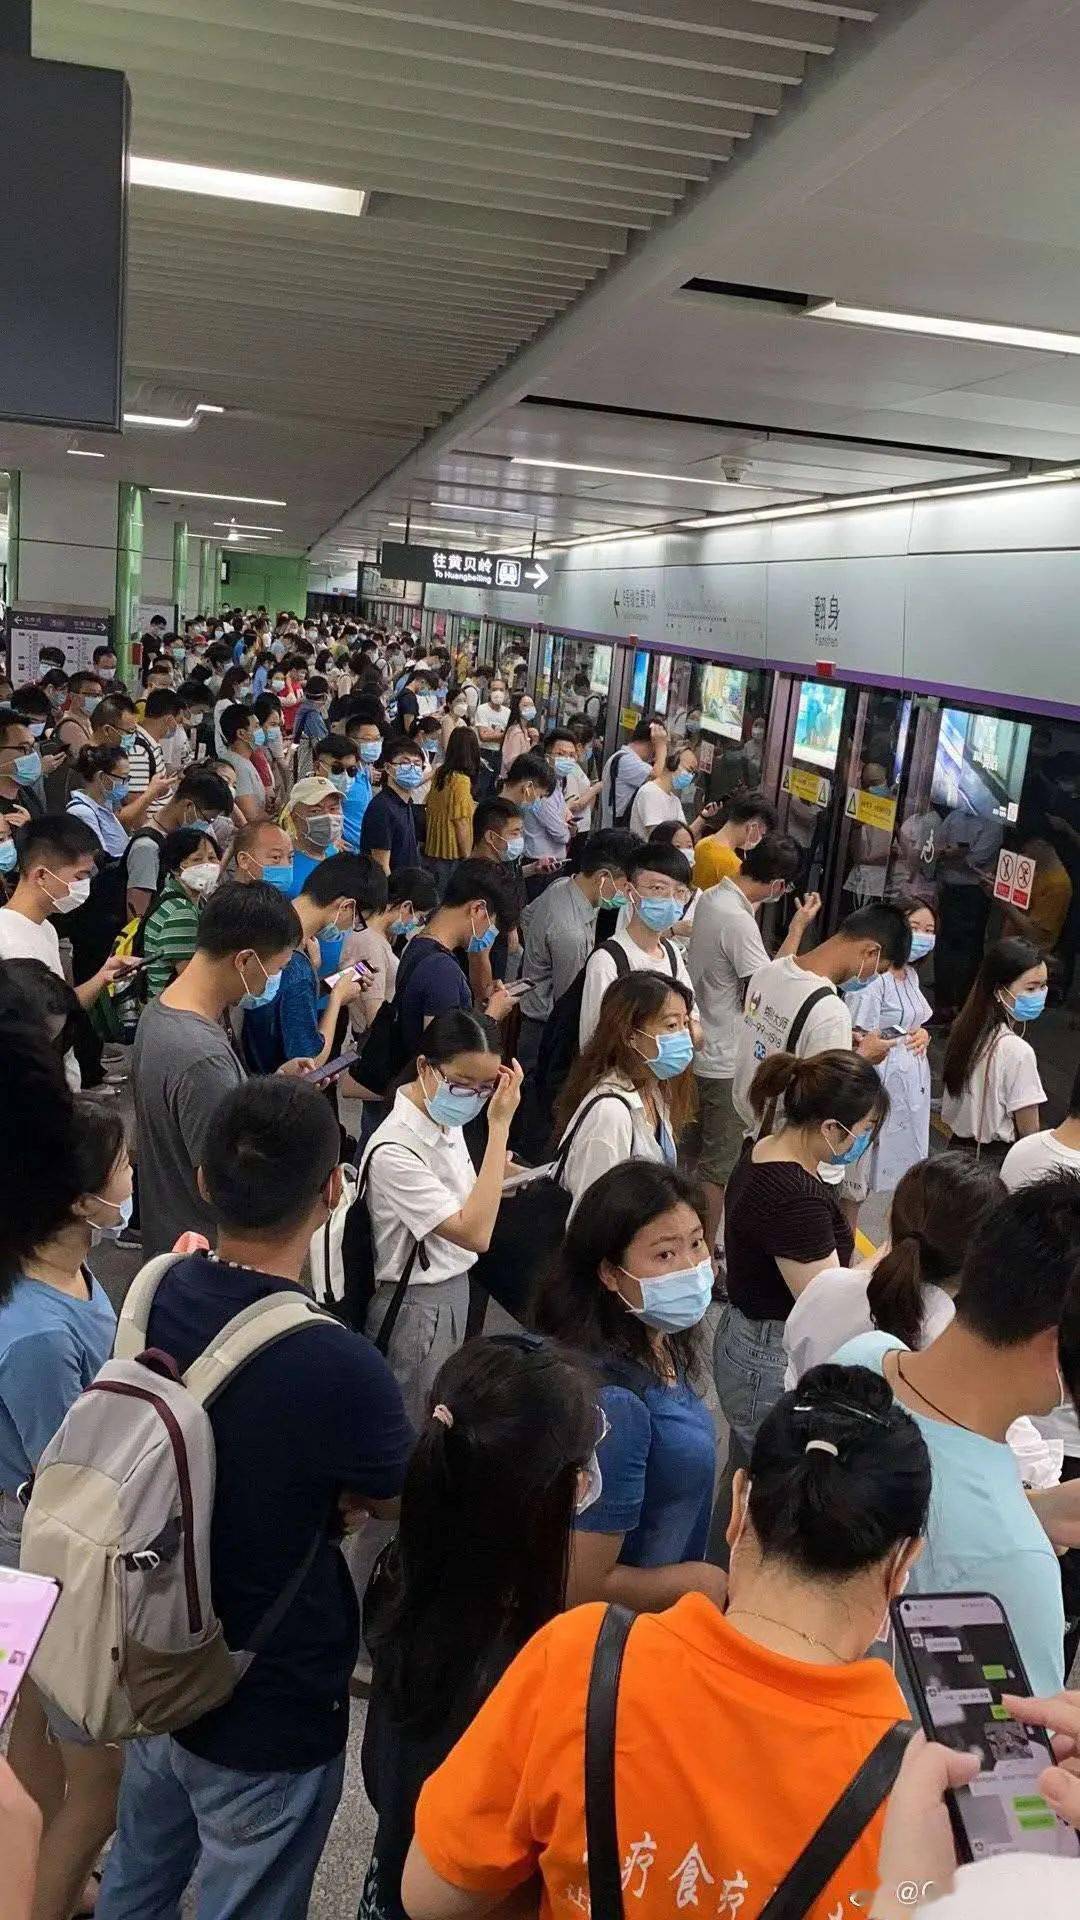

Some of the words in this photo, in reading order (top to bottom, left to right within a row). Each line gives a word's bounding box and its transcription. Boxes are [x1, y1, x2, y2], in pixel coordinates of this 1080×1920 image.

[433, 553, 492, 573] 往黄贝岭
[444, 571, 492, 584] Huangbeiling
[815, 595, 840, 630] 翻身
